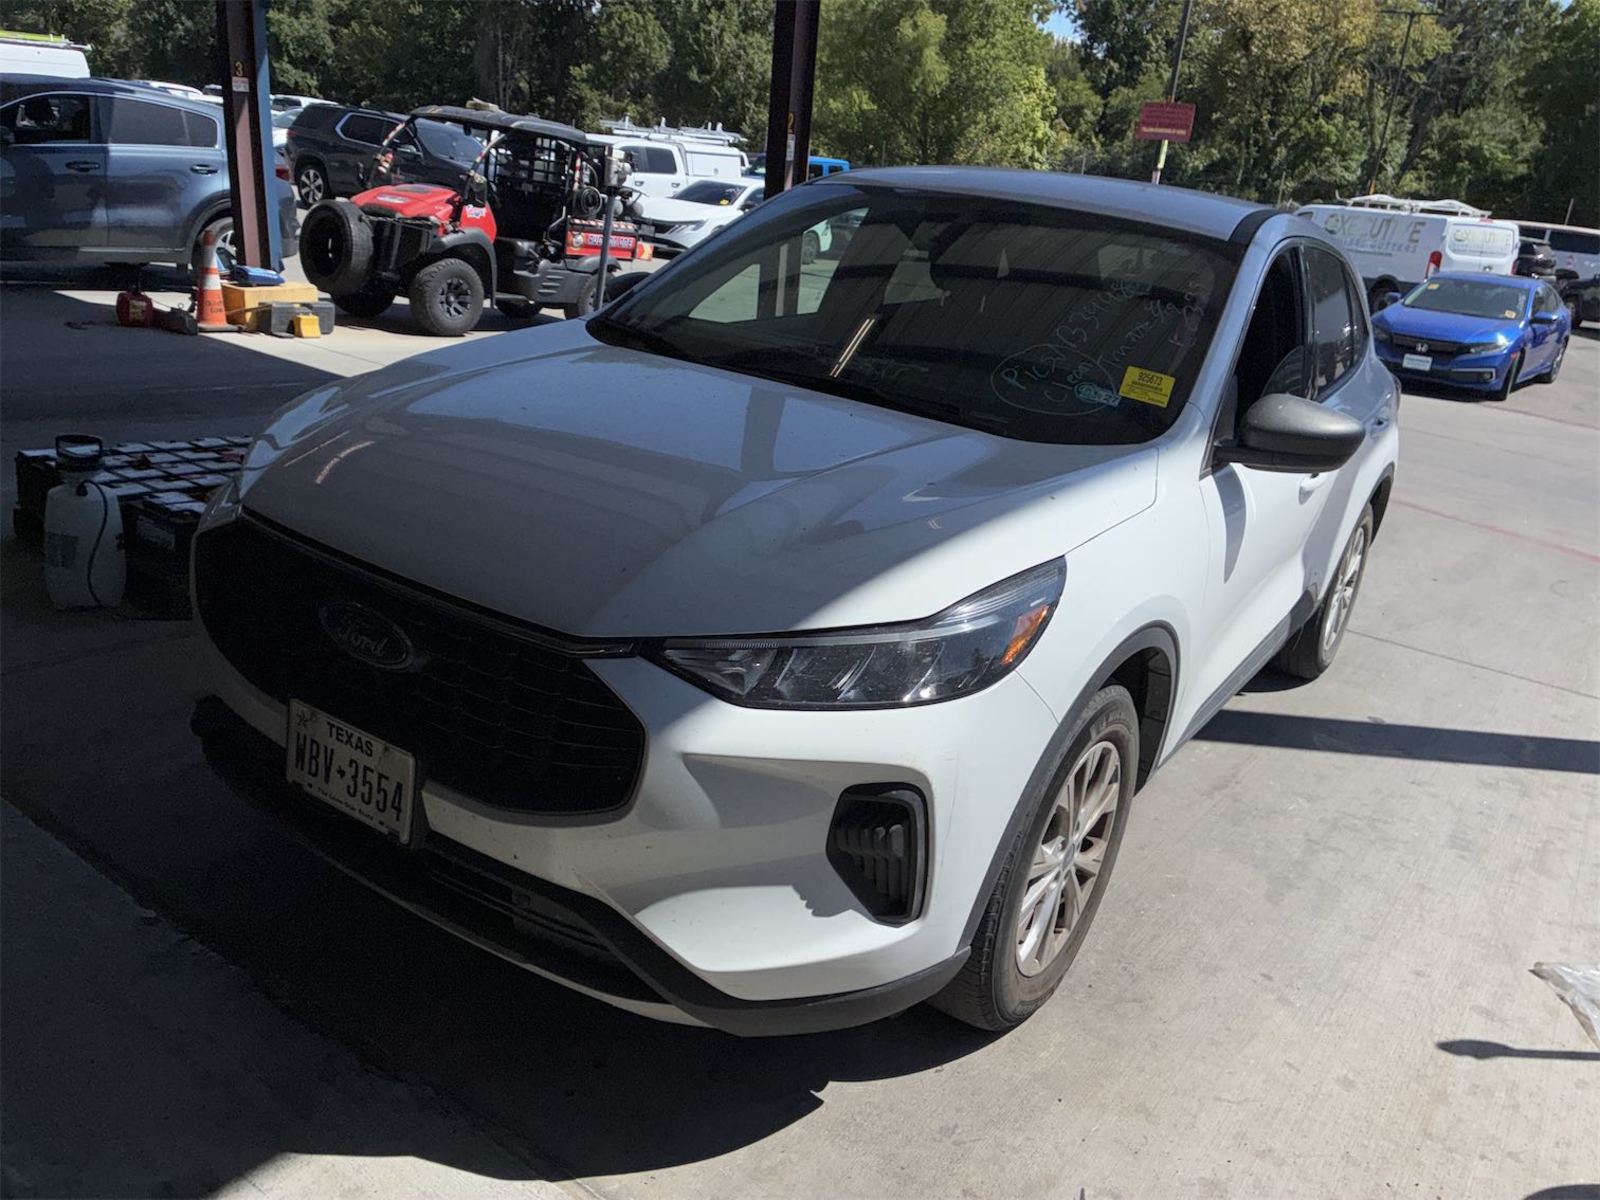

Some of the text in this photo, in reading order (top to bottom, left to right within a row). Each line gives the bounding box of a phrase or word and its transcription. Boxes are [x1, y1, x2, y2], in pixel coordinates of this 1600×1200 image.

[234, 61, 244, 77] 3
[787, 112, 795, 134] 2
[336, 616, 388, 657] Ford
[326, 721, 374, 757] TEXAS
